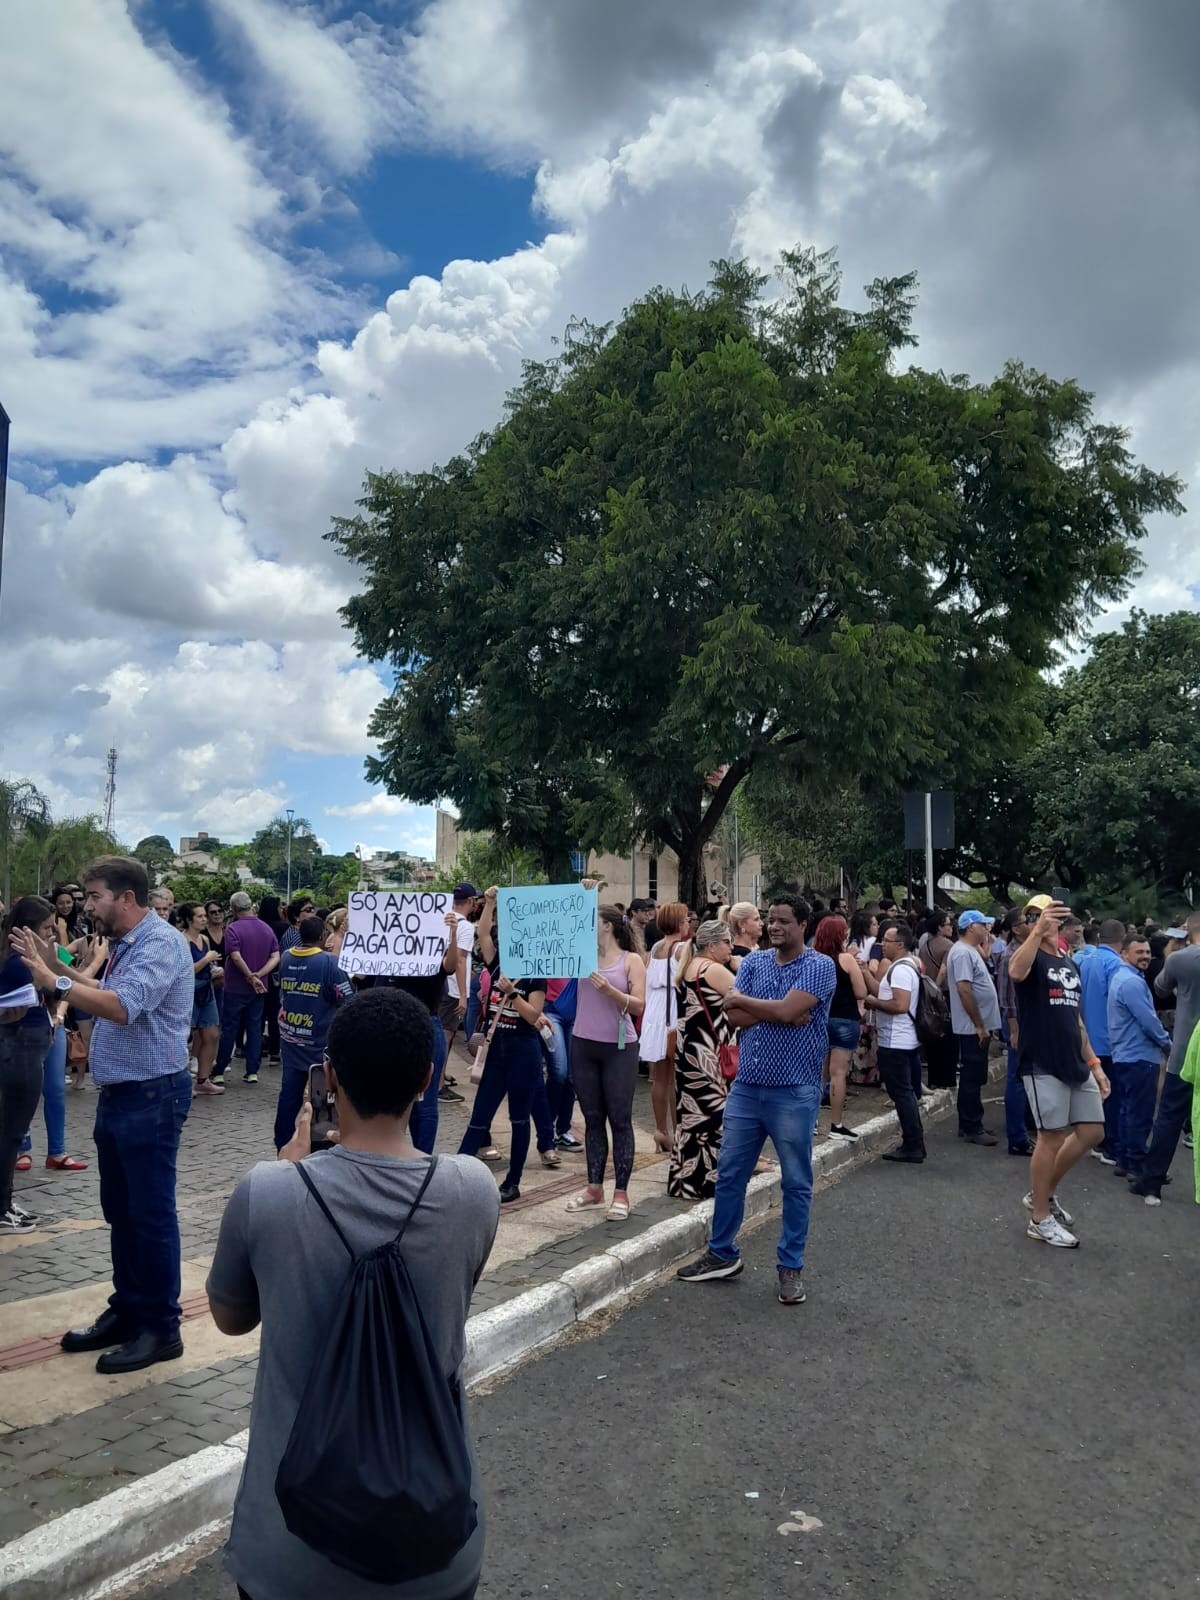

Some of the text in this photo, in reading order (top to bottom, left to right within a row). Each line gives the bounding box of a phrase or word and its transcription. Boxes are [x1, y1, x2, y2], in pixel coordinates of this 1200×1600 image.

[351, 891, 447, 914] SÓ AMOR
[372, 912, 420, 934] NÃO
[511, 920, 564, 943] SALARIAL
[343, 932, 388, 955] PAGA
[509, 942, 524, 958] NÃO
[536, 938, 567, 956] FAVOR
[569, 934, 576, 956] É
[340, 955, 406, 976] #DIGNIDADE
[520, 956, 581, 977] DIREITO!
